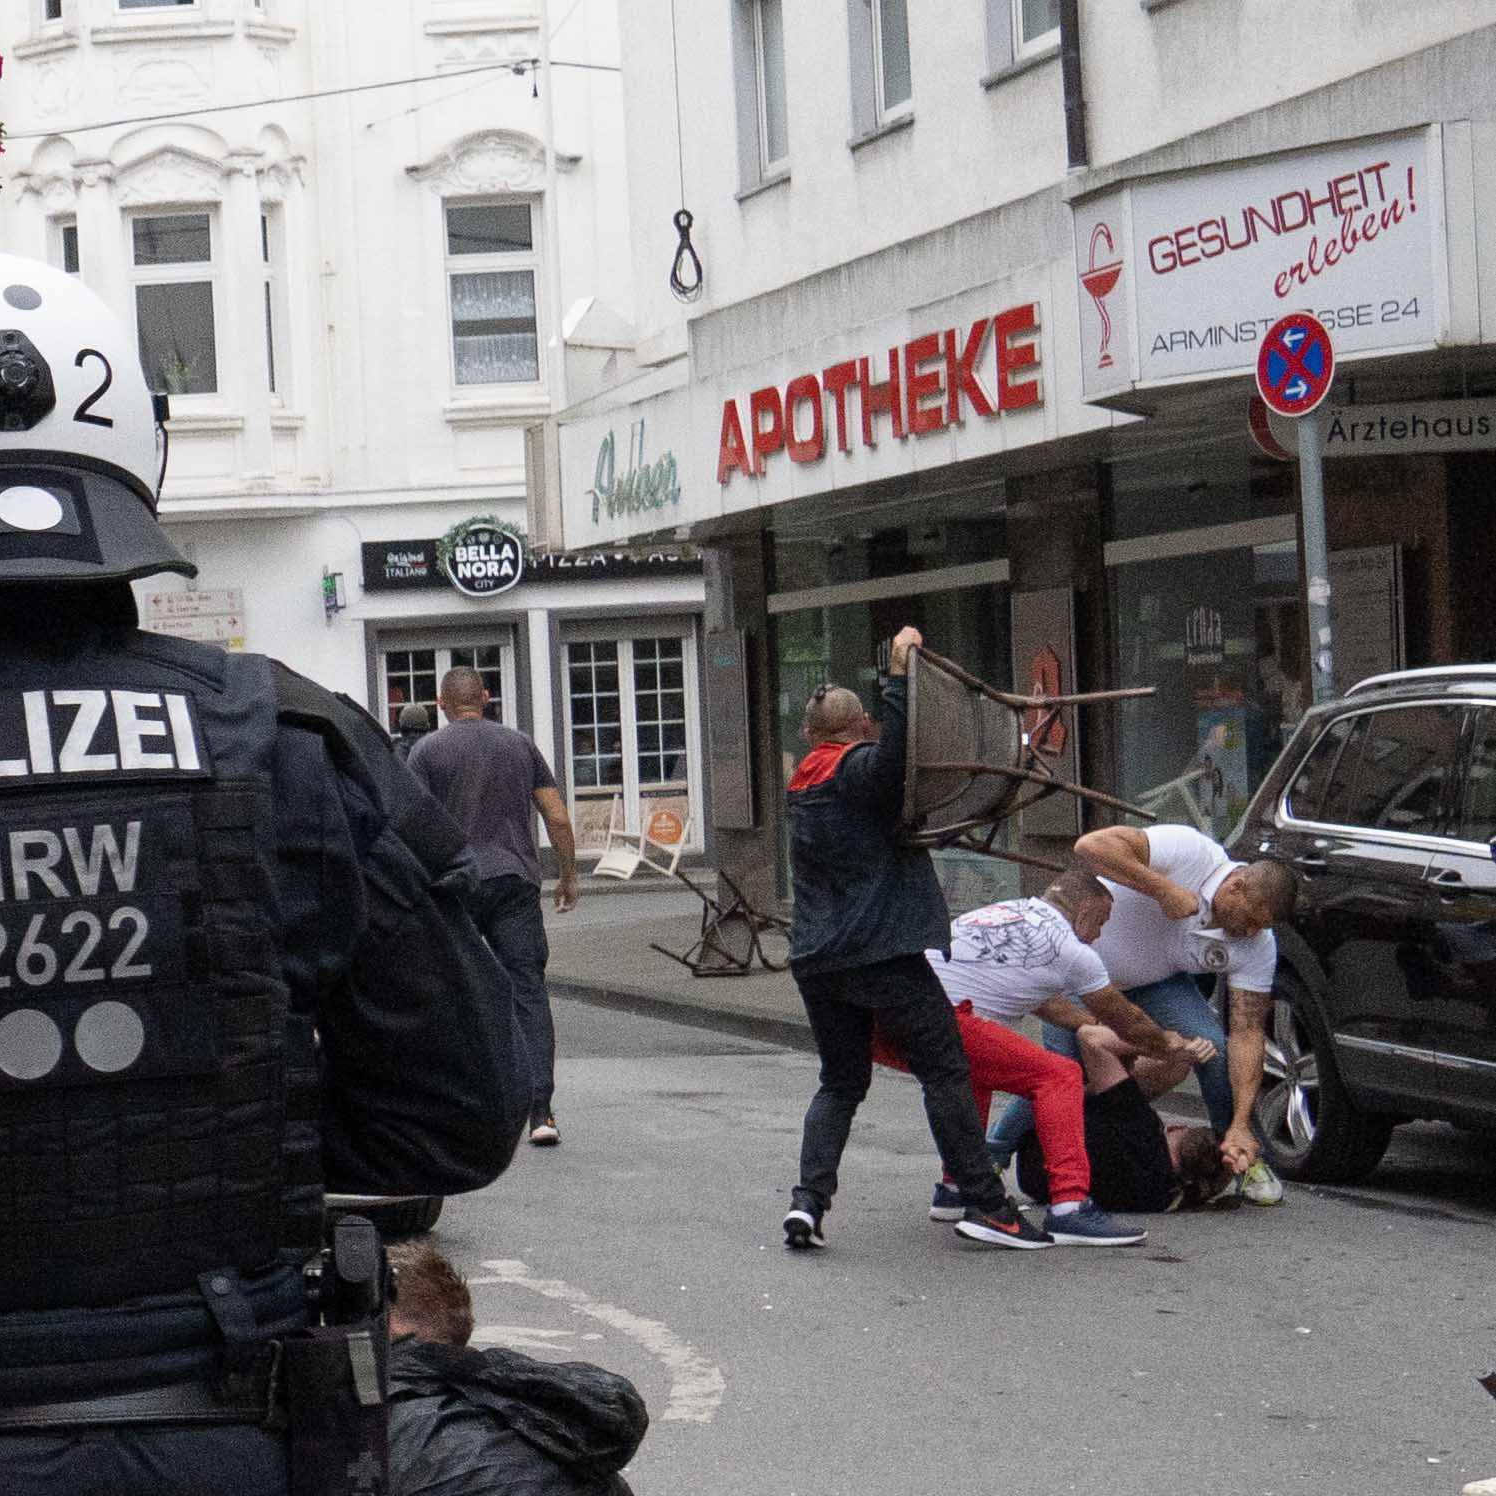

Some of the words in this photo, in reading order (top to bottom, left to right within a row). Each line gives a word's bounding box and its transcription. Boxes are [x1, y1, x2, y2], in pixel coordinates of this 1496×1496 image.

[1148, 161, 1391, 275] GESUNDHEIT
[1150, 303, 1373, 356] ARMINSTSSE
[1380, 297, 1421, 324] 24
[72, 348, 114, 429] 2
[717, 302, 1043, 485] APOTHEKE
[1326, 411, 1491, 443] Ärztehaus
[455, 543, 515, 562] BELLA
[457, 561, 514, 579] NORA
[474, 579, 495, 589] CITY
